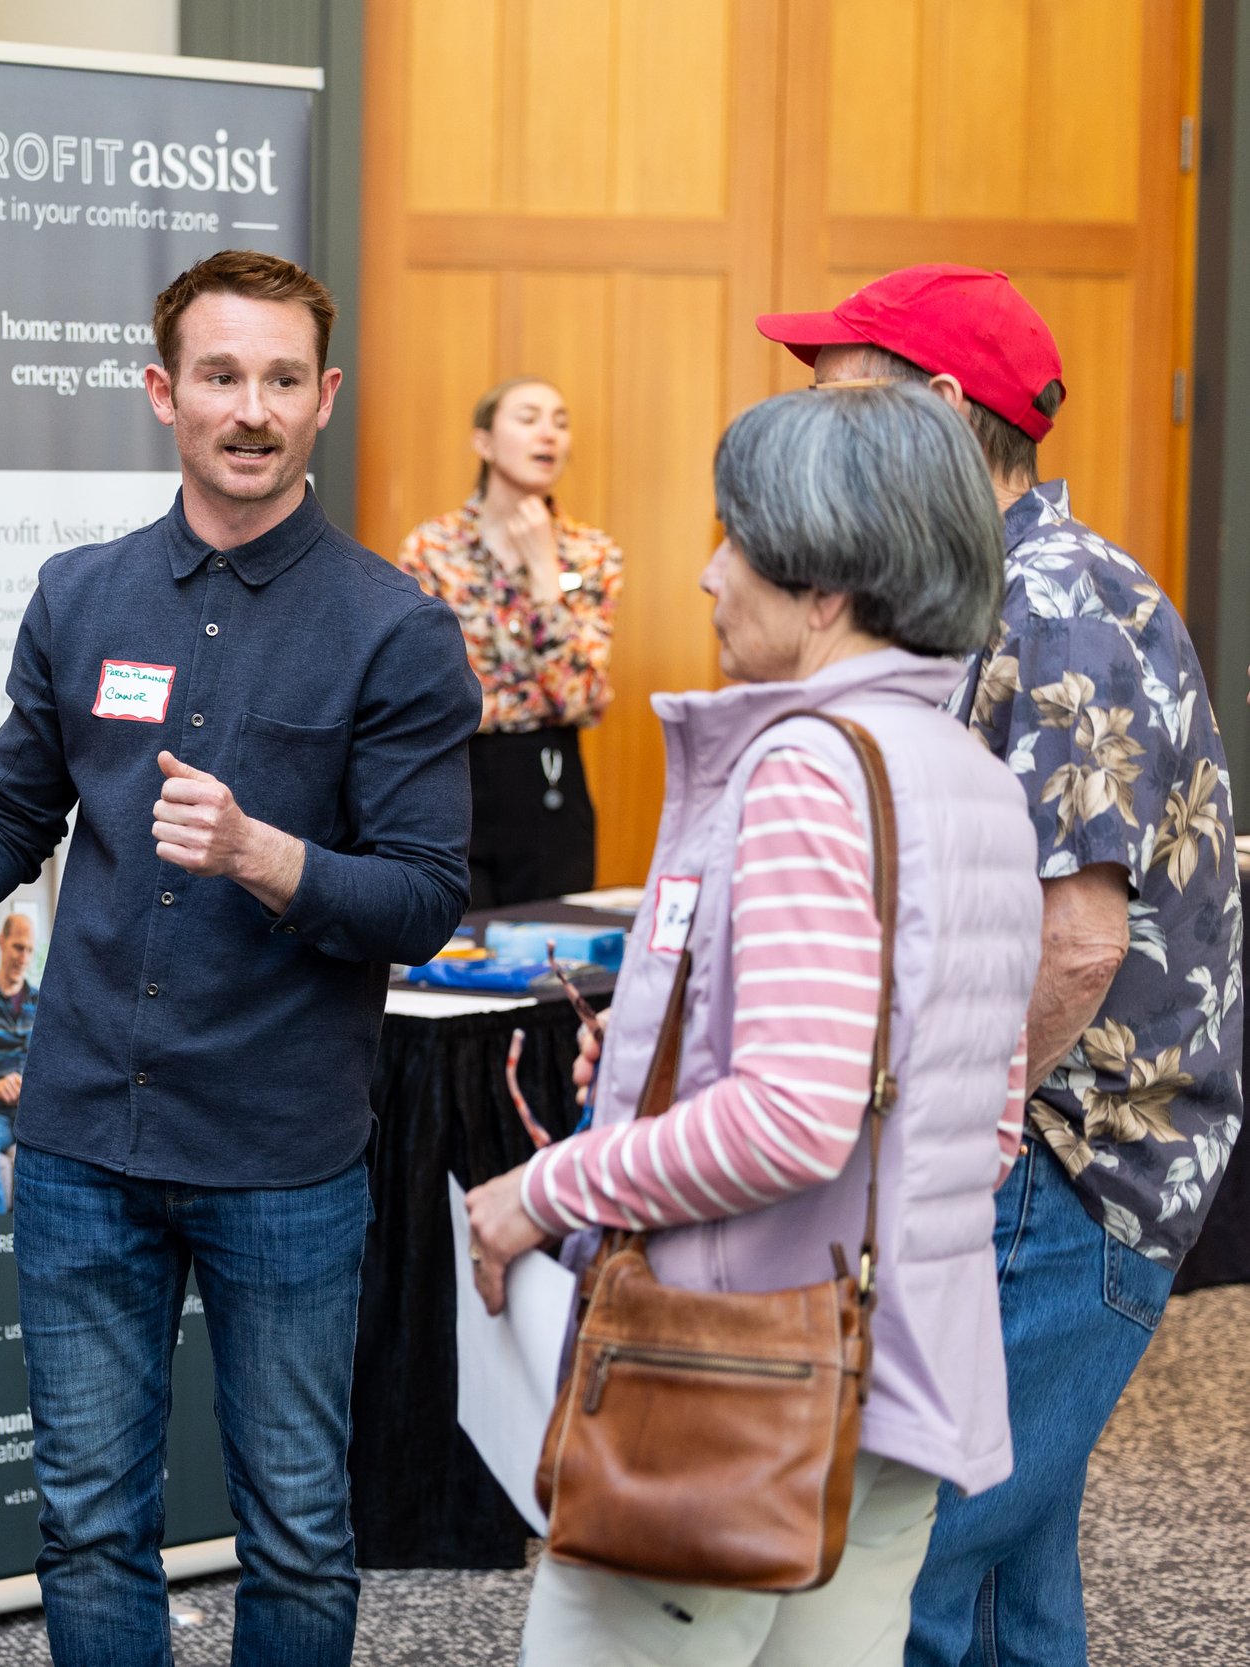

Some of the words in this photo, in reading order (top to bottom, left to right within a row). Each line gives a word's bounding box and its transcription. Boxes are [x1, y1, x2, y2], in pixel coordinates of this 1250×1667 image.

[130, 128, 279, 196] assist
[11, 196, 30, 222] in
[33, 203, 81, 231] your
[85, 201, 167, 230] comfort
[170, 211, 219, 233] zone
[1, 310, 62, 342] home
[65, 321, 121, 343] more
[11, 363, 83, 396] energy
[49, 518, 105, 545] Assist
[5, 578, 15, 594] a
[4, 1487, 38, 1506] with
